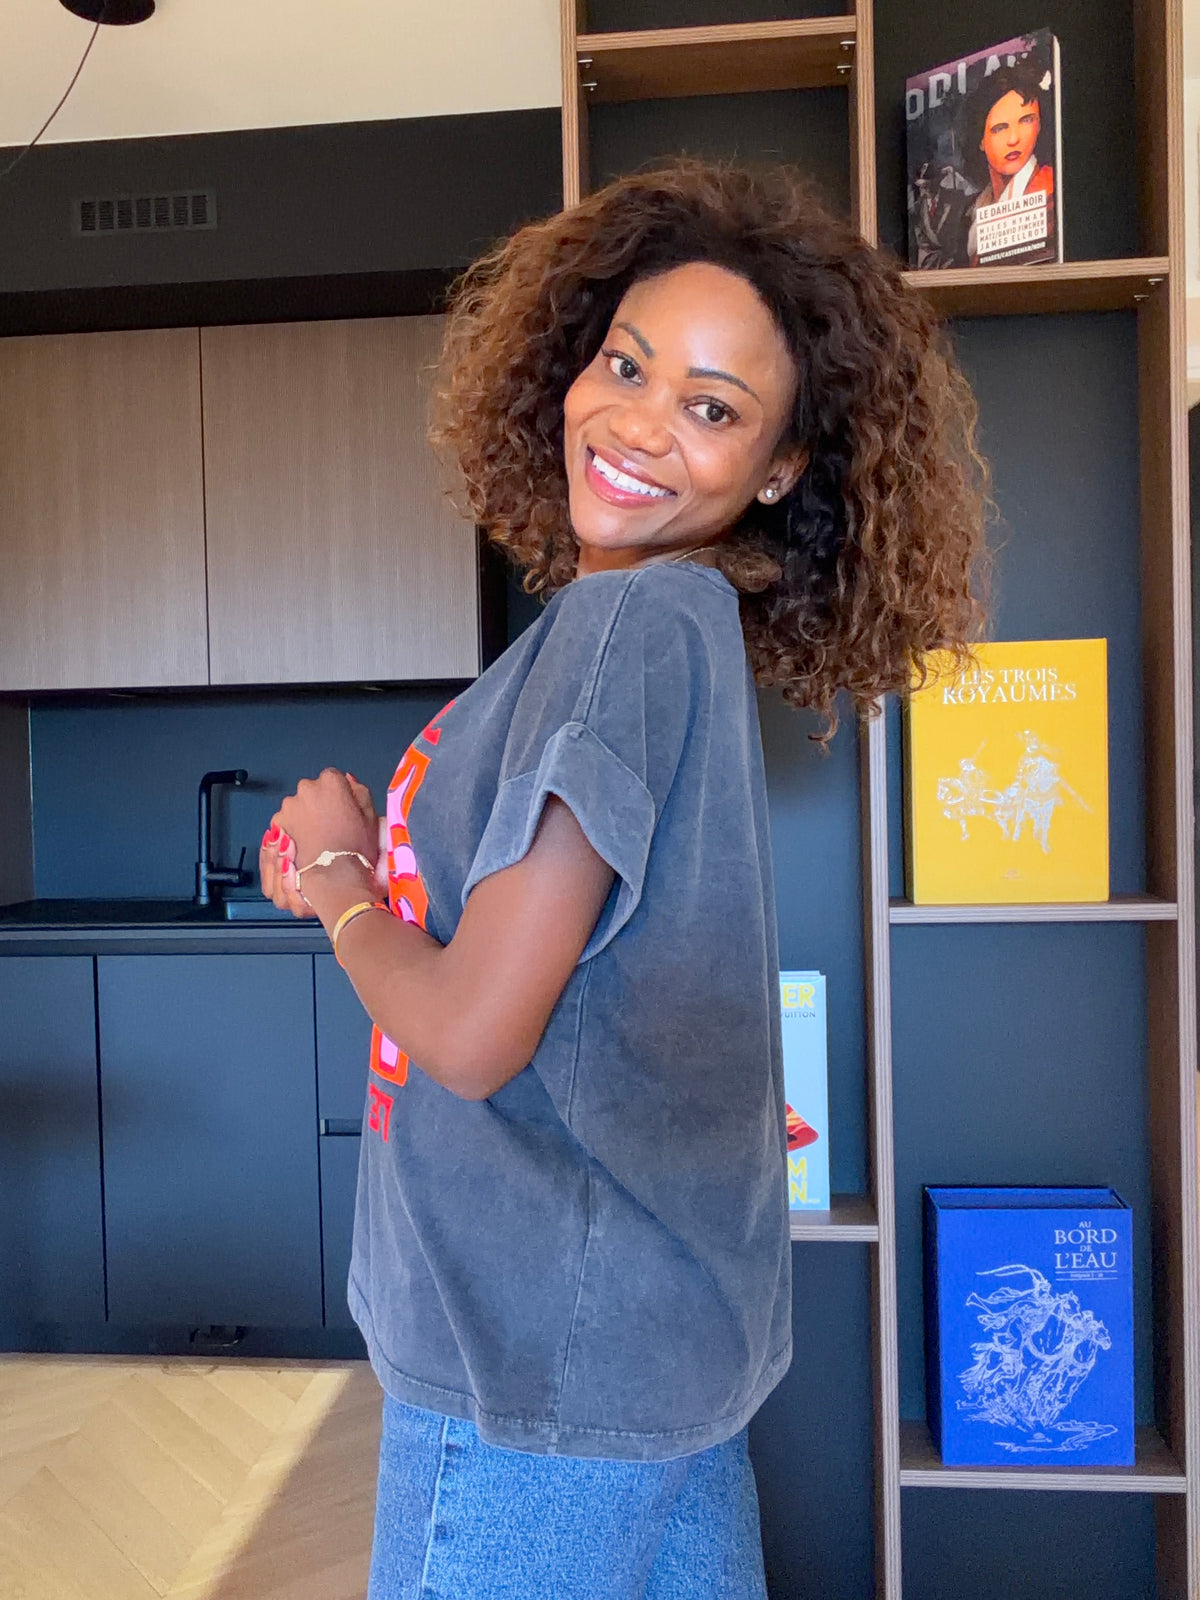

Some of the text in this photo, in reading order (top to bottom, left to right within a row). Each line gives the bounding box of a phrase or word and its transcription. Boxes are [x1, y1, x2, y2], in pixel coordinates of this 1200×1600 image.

[980, 194, 1043, 220] LE DAHLIA NOIR
[980, 221, 1006, 234] MILES
[980, 228, 1045, 251] JAMES ELLROY
[961, 667, 1058, 686] LES TROIS
[942, 683, 1077, 705] ROYAUMES
[1054, 1228, 1117, 1245] BORD
[1054, 1252, 1117, 1269] L'EAU
